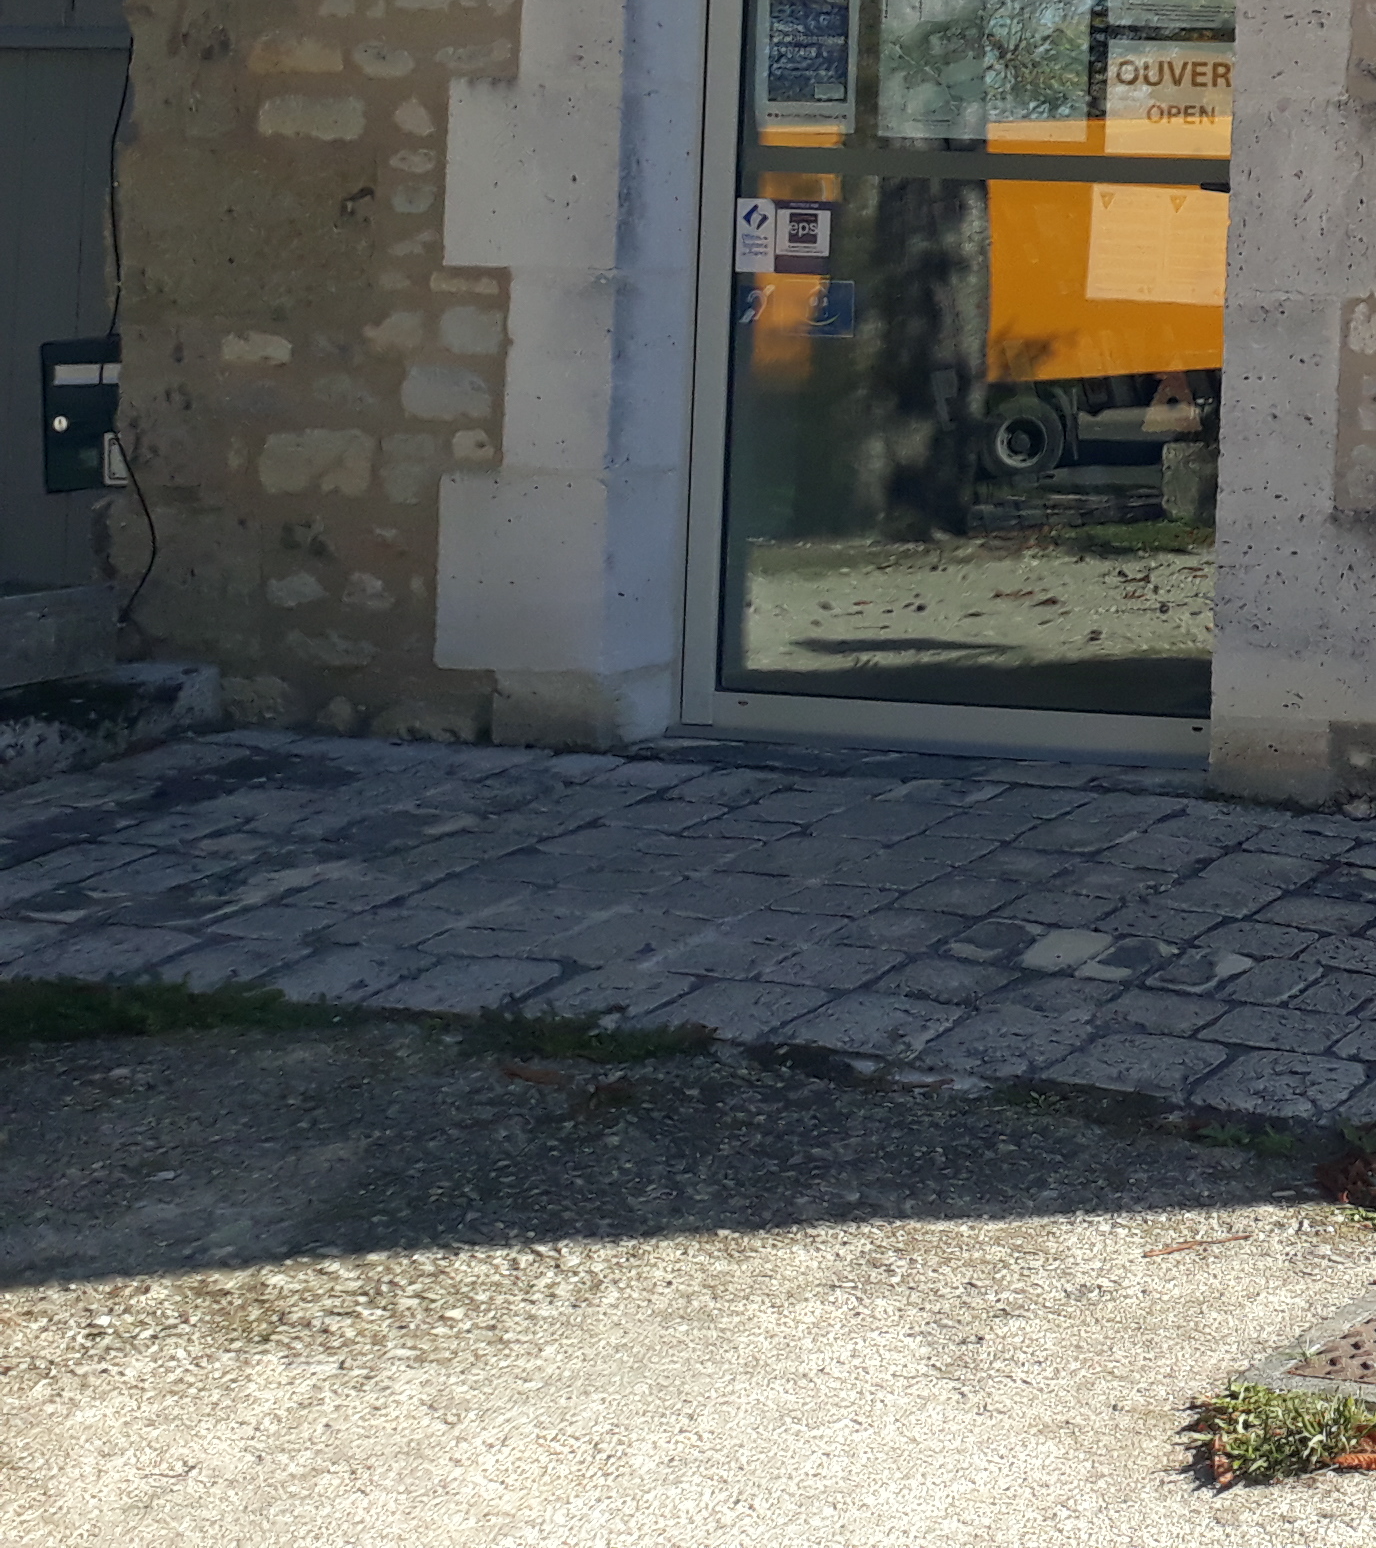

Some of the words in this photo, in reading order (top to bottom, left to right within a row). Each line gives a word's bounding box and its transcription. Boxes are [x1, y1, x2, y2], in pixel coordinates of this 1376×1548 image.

[1115, 59, 1232, 88] OUVER
[1146, 104, 1216, 125] OPEN
[789, 222, 818, 239] eps
